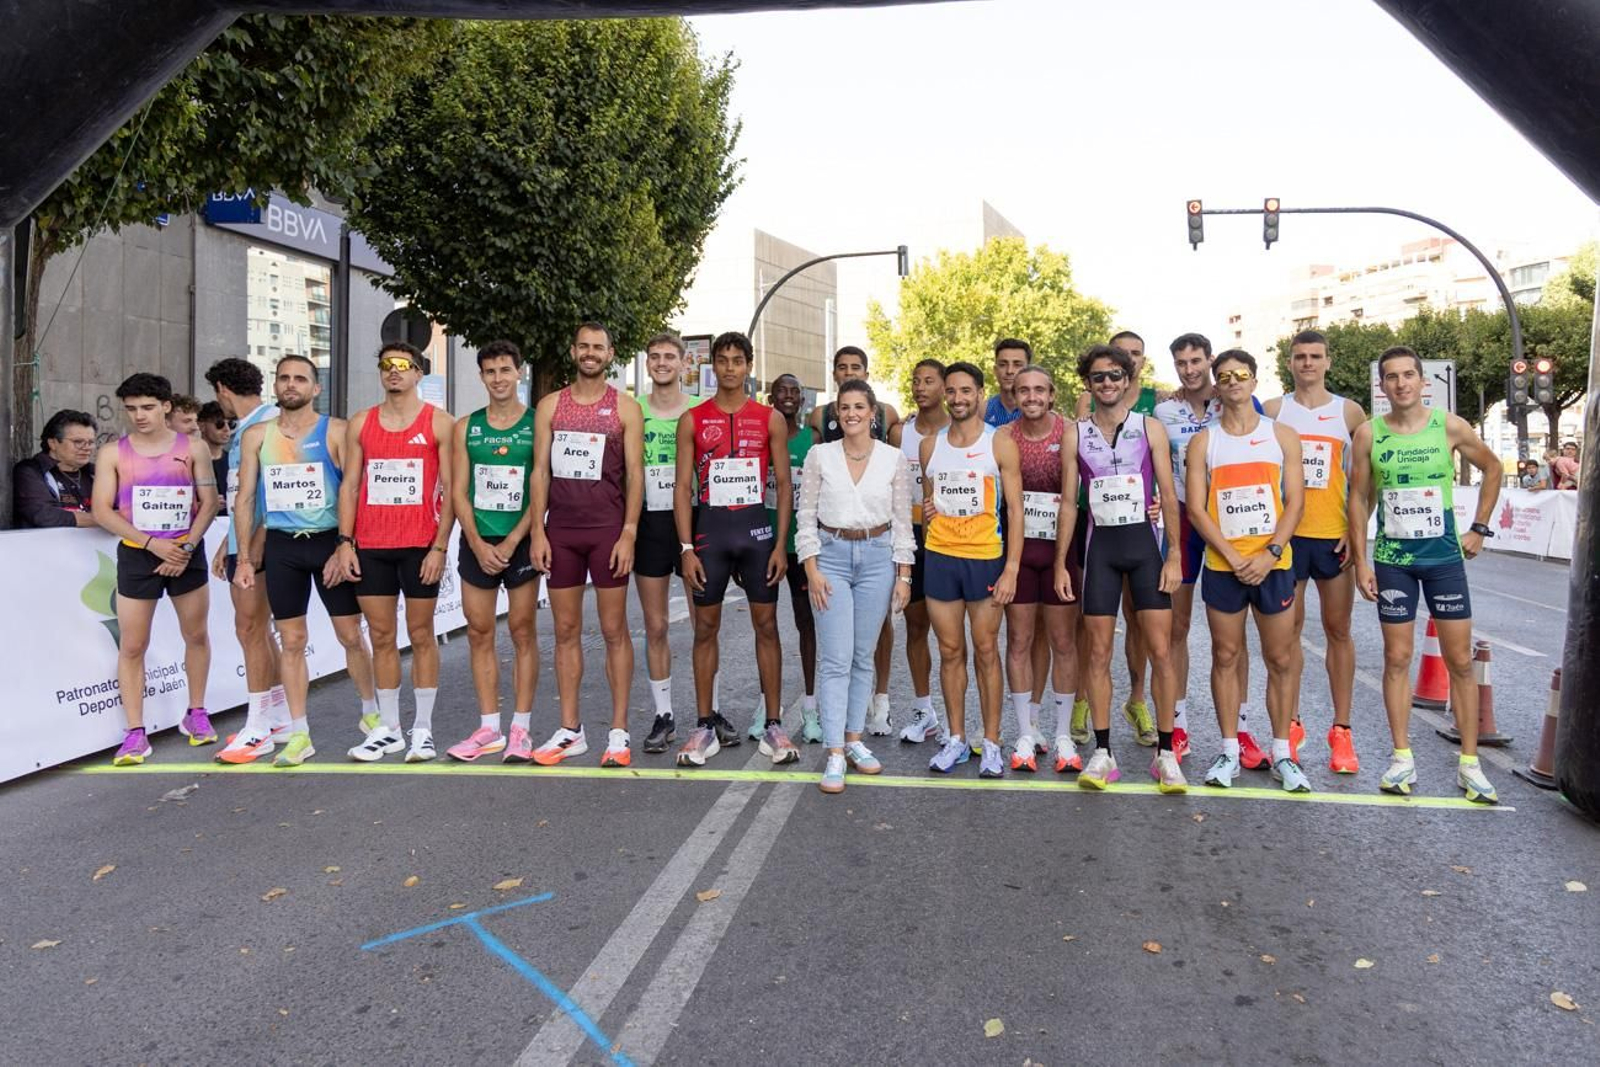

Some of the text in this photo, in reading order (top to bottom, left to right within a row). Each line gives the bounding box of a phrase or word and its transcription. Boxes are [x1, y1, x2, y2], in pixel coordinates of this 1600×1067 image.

[267, 203, 327, 244] BBVA
[558, 434, 568, 442] 37
[564, 447, 590, 457] Arce
[1397, 447, 1440, 458] Fundación
[1303, 457, 1325, 466] ada
[1397, 455, 1430, 463] Unicaja
[374, 462, 384, 470] 37
[589, 460, 596, 470] 3
[715, 462, 725, 470] 37
[910, 463, 919, 471] 37
[270, 468, 281, 476] 37
[479, 467, 488, 475] 37
[650, 468, 660, 477] 37
[1316, 469, 1323, 478] 8
[374, 475, 416, 483] Pereira
[713, 475, 756, 484] Guzman
[938, 472, 947, 481] 37
[273, 480, 316, 490] Martos
[486, 481, 509, 490] Ruiz
[1094, 480, 1104, 489] 37
[139, 489, 151, 497] 37
[409, 486, 416, 496] 9
[746, 485, 758, 494] 14
[941, 486, 976, 495] Fontes
[307, 490, 322, 499] 22
[508, 492, 520, 501] 16
[1102, 493, 1130, 502] Saez
[1222, 492, 1232, 500] 37
[1388, 492, 1398, 500] 37
[142, 502, 183, 510] Gaitan
[972, 497, 978, 506] 5
[1132, 502, 1138, 512] 7
[1226, 502, 1266, 514] Oriach
[1394, 506, 1432, 515] Casas
[175, 512, 188, 521] 17
[1025, 508, 1055, 518] Miron
[1263, 513, 1270, 523] 2
[1427, 517, 1441, 527] 18
[160, 676, 186, 694] Jaén
[56, 679, 120, 704] Patronato
